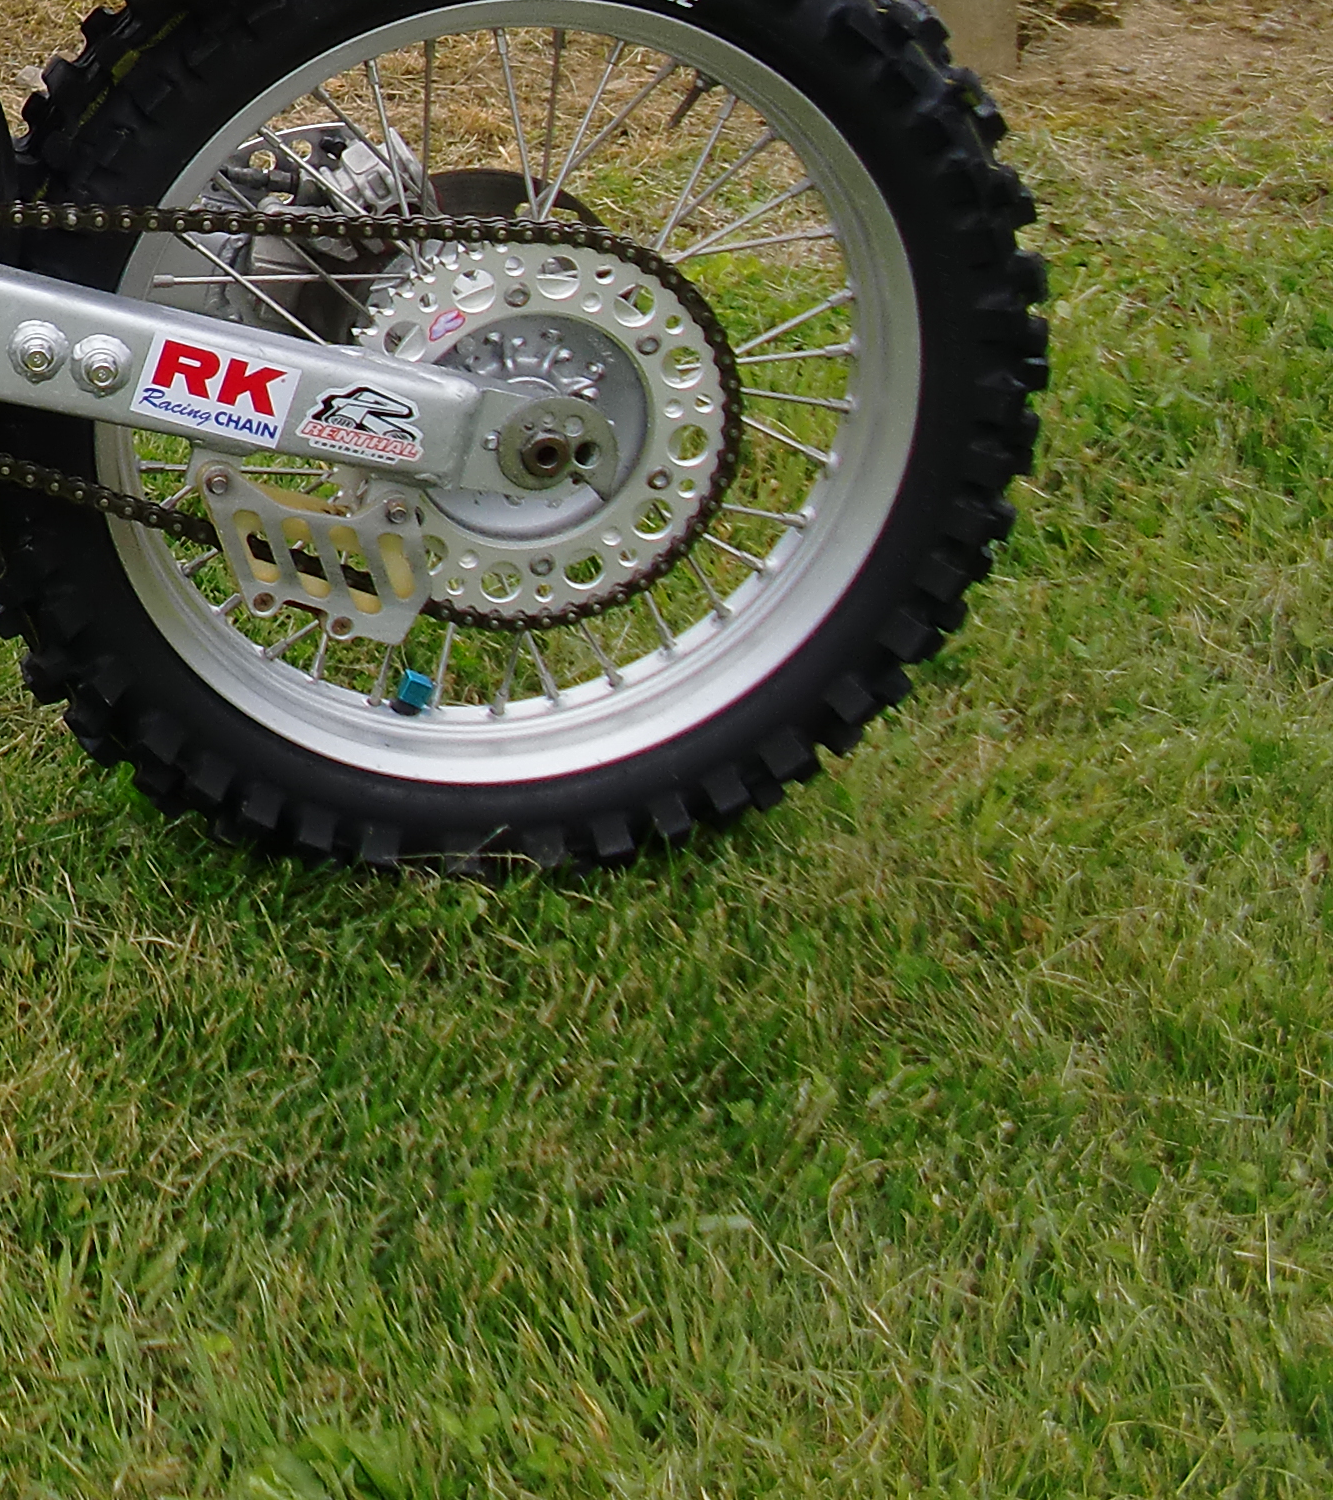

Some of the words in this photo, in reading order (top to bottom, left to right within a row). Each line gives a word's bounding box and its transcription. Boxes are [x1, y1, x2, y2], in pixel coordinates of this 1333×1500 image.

[151, 339, 288, 417] RK
[139, 387, 213, 427] Racing
[214, 411, 279, 440] CHAIN
[302, 421, 418, 458] RENTHAL
